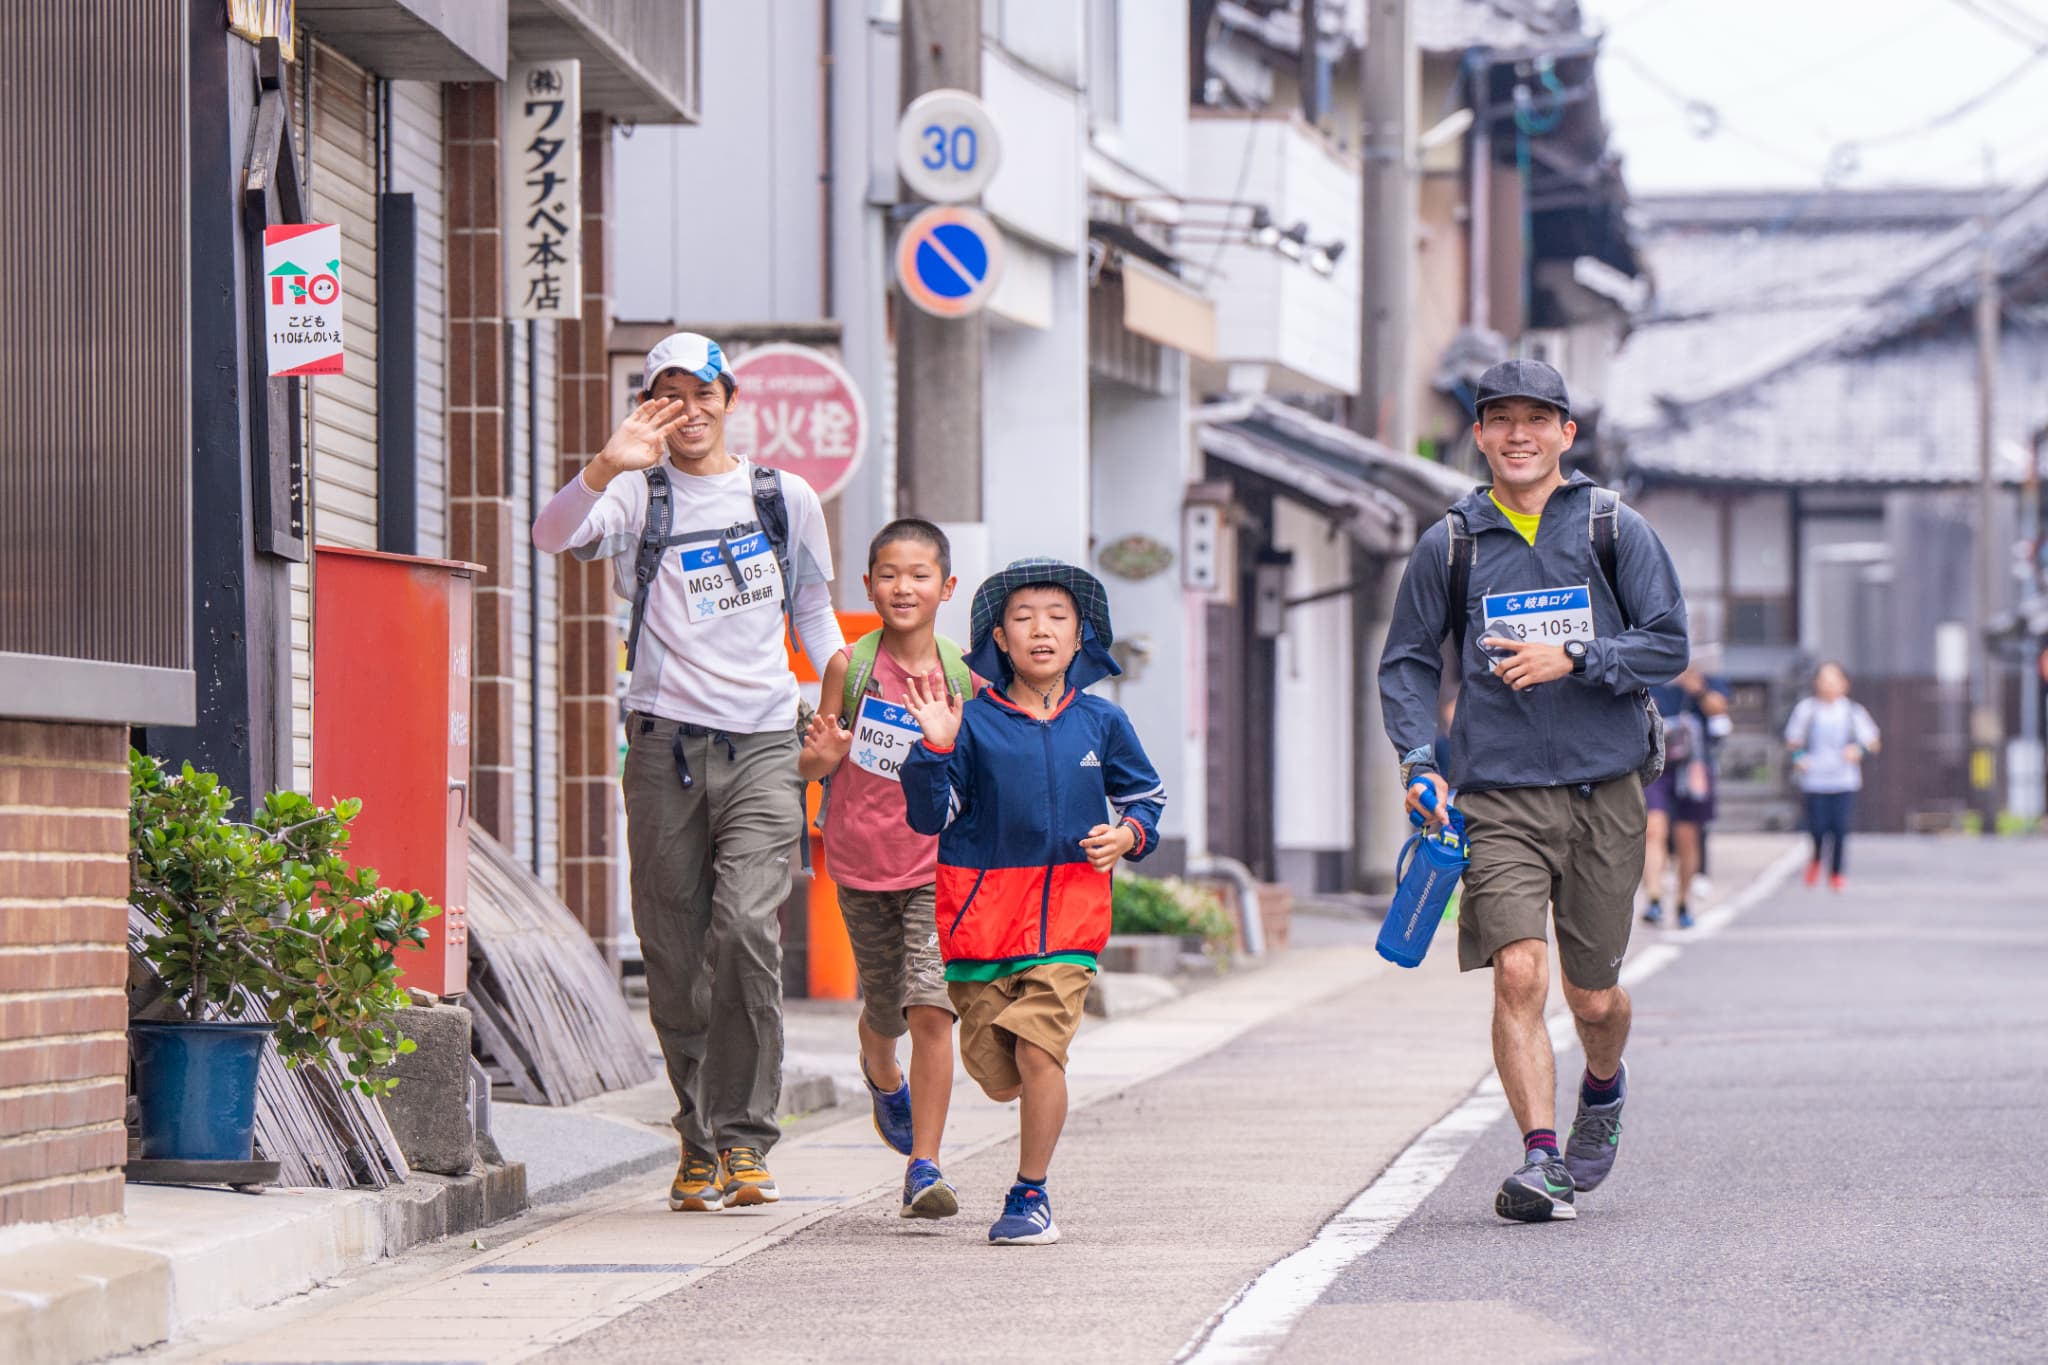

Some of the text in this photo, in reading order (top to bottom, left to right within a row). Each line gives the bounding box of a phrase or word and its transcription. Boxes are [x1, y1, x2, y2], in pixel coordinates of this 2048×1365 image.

[922, 124, 977, 172] 30
[288, 315, 326, 329] こども
[272, 331, 342, 345] 110ばんのいえ
[689, 562, 776, 595] MG3-05-3
[719, 585, 773, 611] OKB総研
[1524, 592, 1574, 609] 岐阜ロゲ
[1508, 618, 1589, 639] 3-105-2
